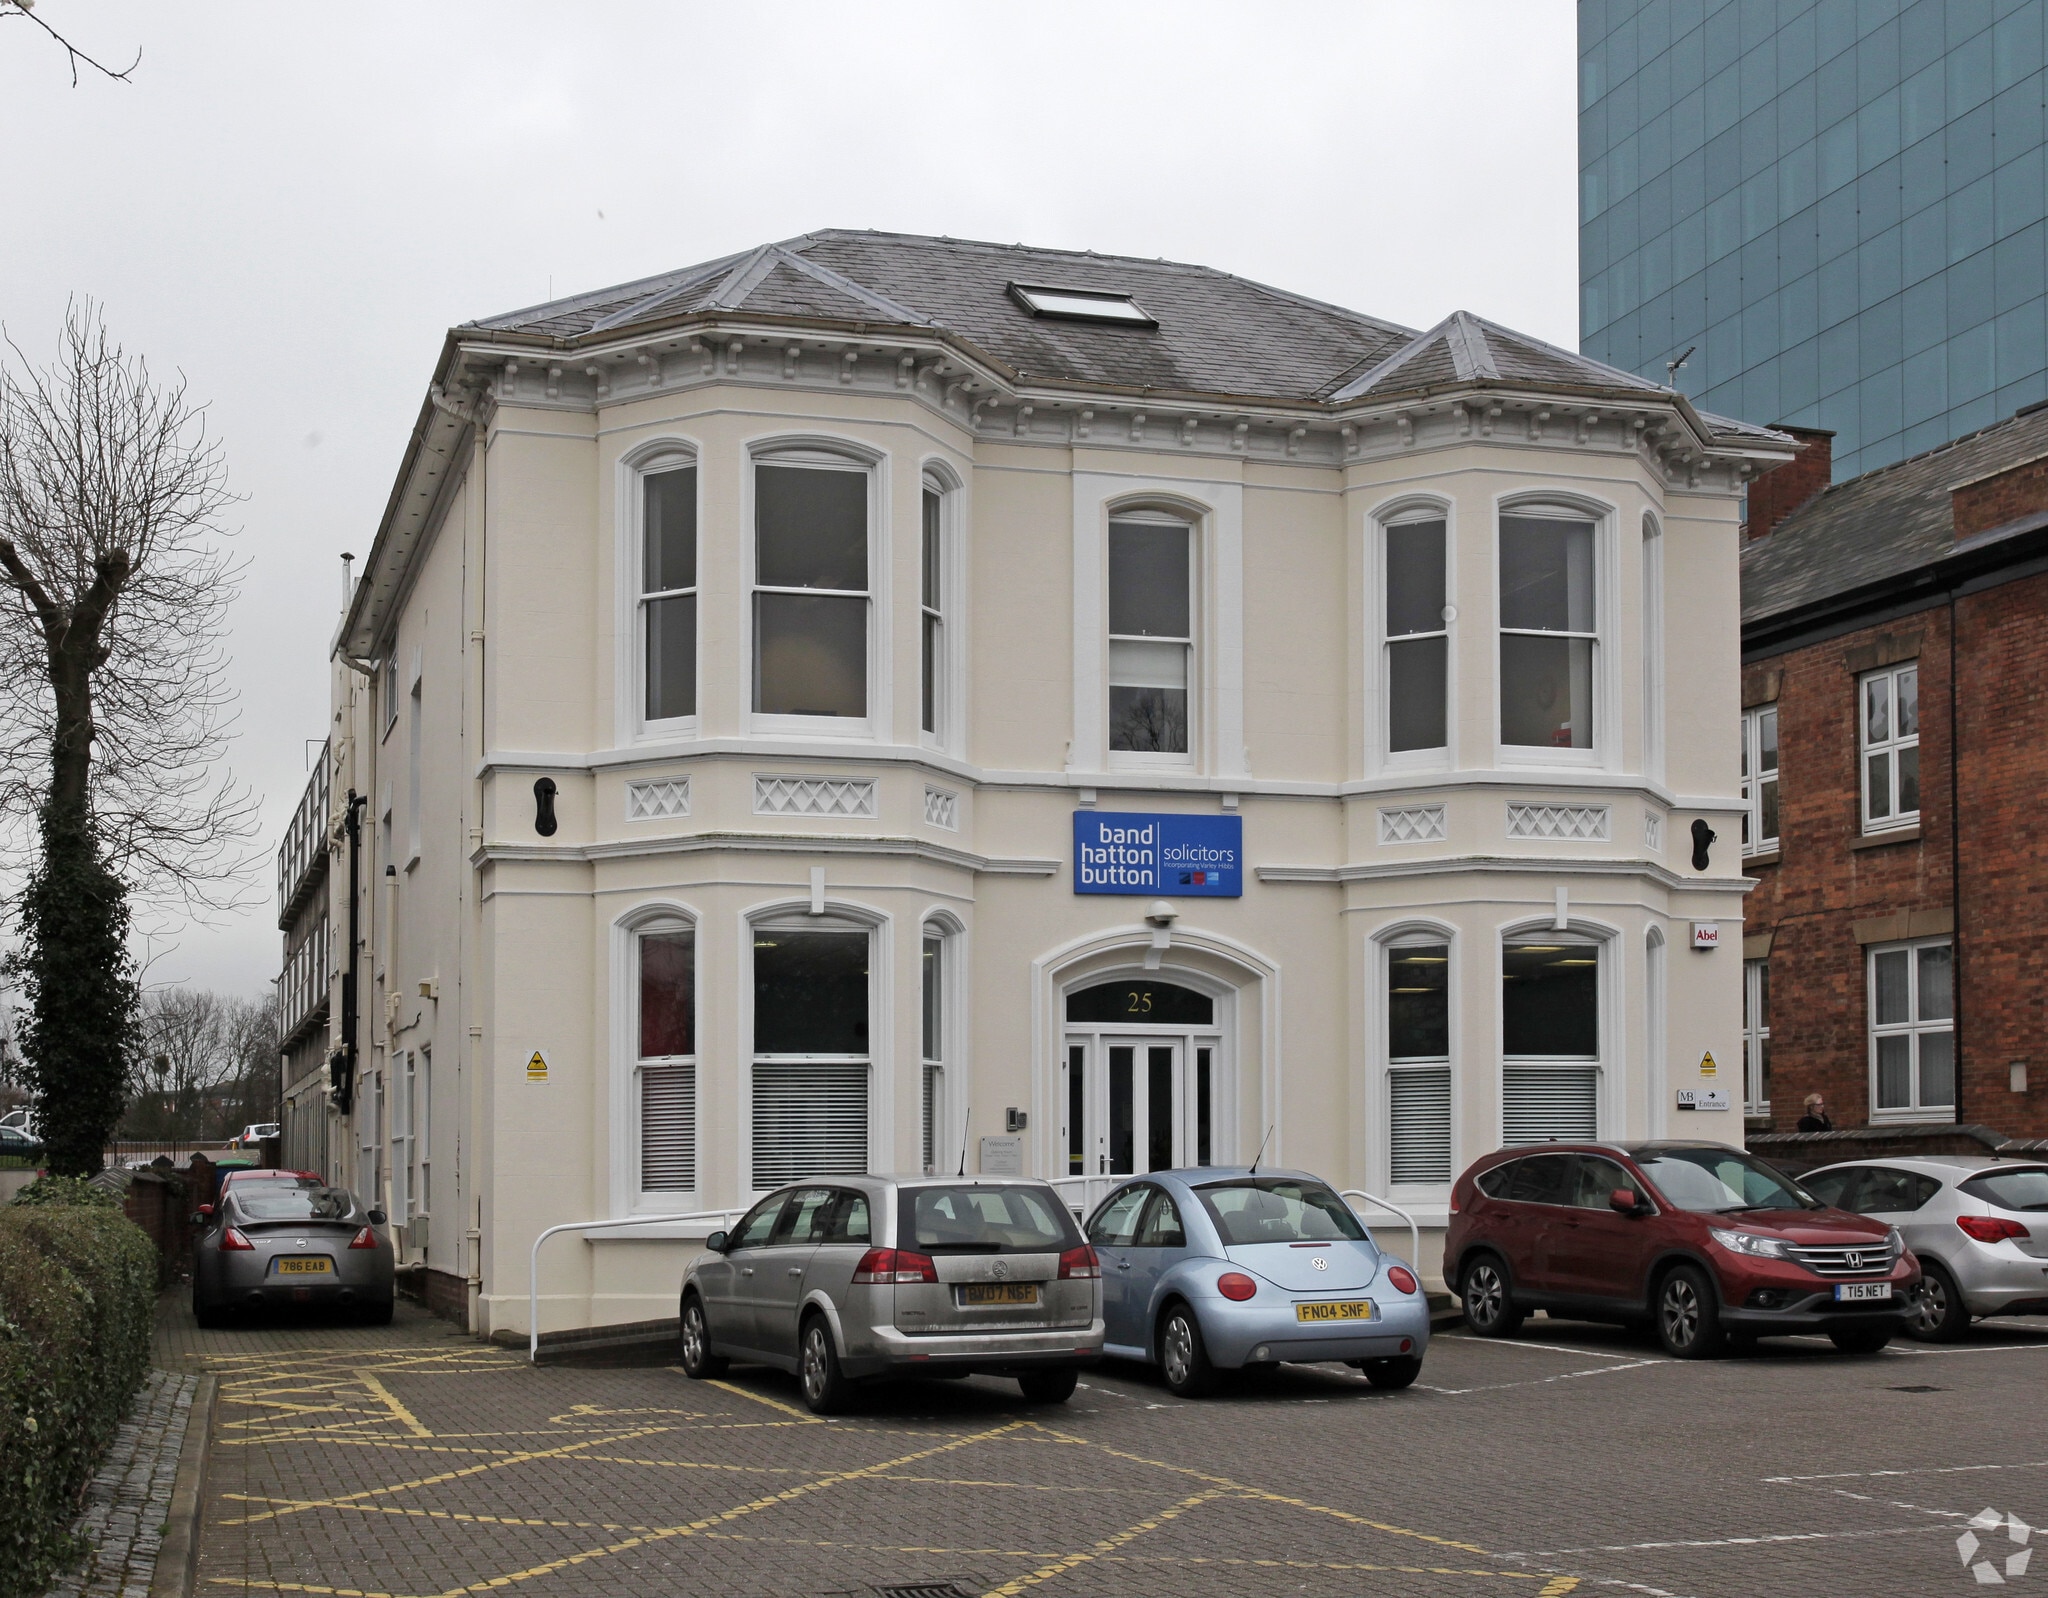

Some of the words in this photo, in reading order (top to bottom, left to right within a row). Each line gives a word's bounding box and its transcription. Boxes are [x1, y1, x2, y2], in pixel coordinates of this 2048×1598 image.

[1100, 822, 1153, 845] band
[1081, 842, 1153, 865] hatton
[1163, 844, 1234, 862] solicitors
[1163, 861, 1200, 870] Incorporating
[1081, 863, 1153, 886] button
[1696, 930, 1718, 941] Abel
[1127, 992, 1152, 1013] 25
[1680, 1091, 1694, 1102] MB
[283, 1261, 303, 1271] 786
[305, 1261, 325, 1271] EAB
[1007, 1285, 1033, 1300] NSF
[1866, 1285, 1885, 1297] NET
[1302, 1305, 1337, 1319] FN04
[1340, 1304, 1364, 1317] SNF
